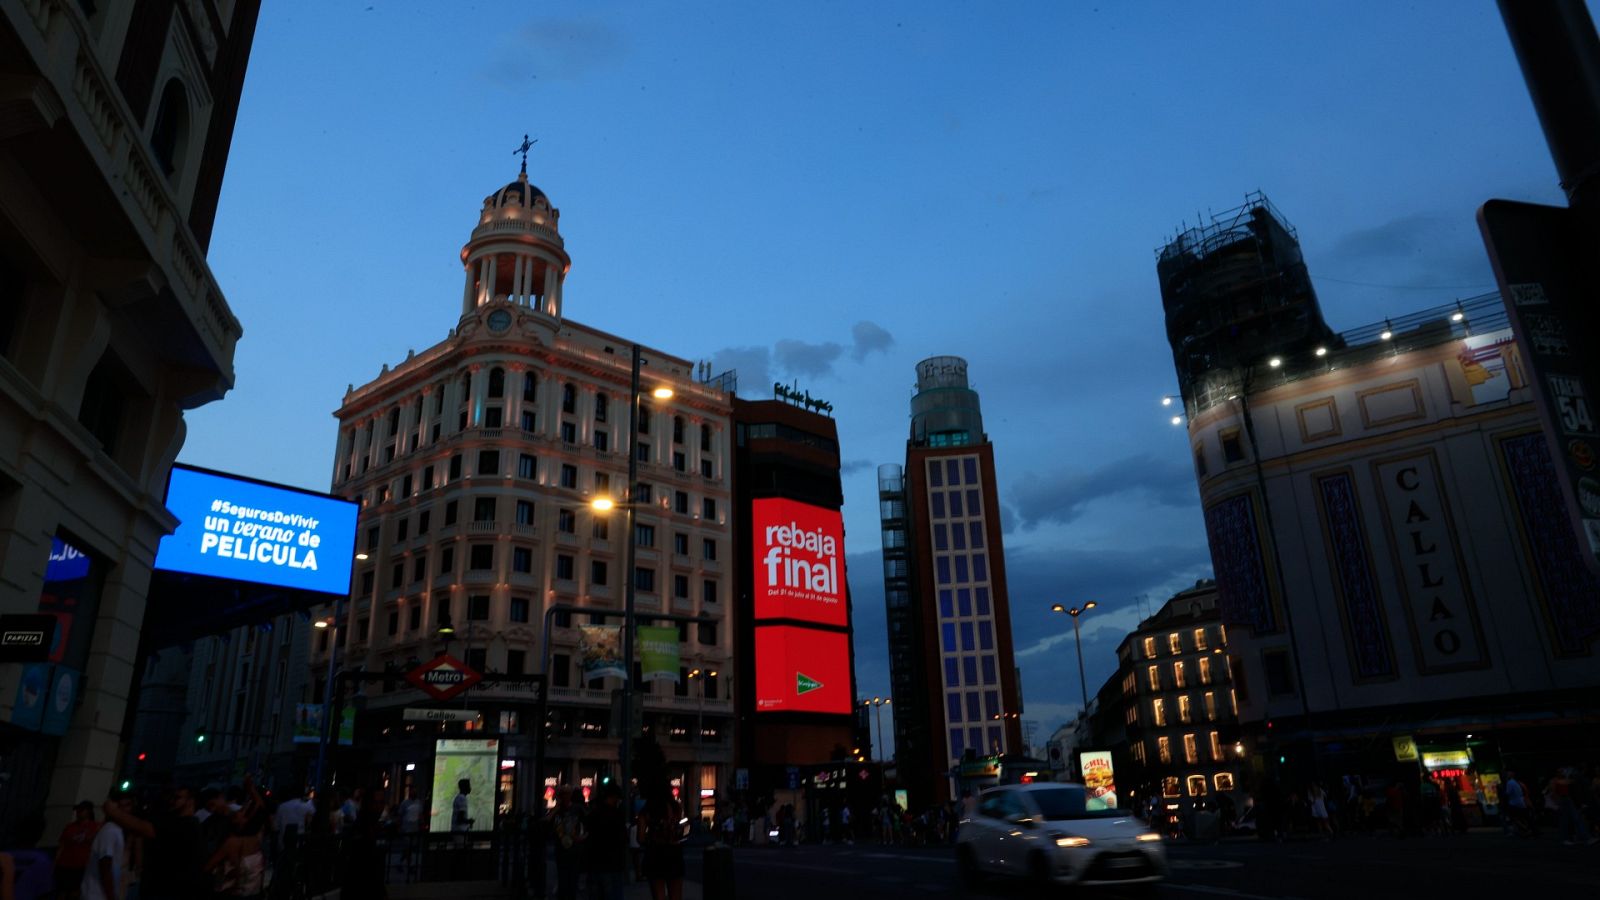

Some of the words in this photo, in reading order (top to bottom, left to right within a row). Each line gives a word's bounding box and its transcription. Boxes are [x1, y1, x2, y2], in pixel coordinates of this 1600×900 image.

[211, 499, 320, 529] #SegurosDeVivir
[204, 516, 229, 532] un
[233, 521, 295, 543] verano
[298, 530, 321, 548] de
[765, 521, 836, 559] rebaja
[200, 532, 318, 571] PELÍCULA
[1396, 467, 1460, 654] CALLAO
[763, 547, 838, 594] final
[427, 671, 461, 682] Metro
[427, 711, 456, 719] Callao
[1084, 759, 1110, 770] CHILI
